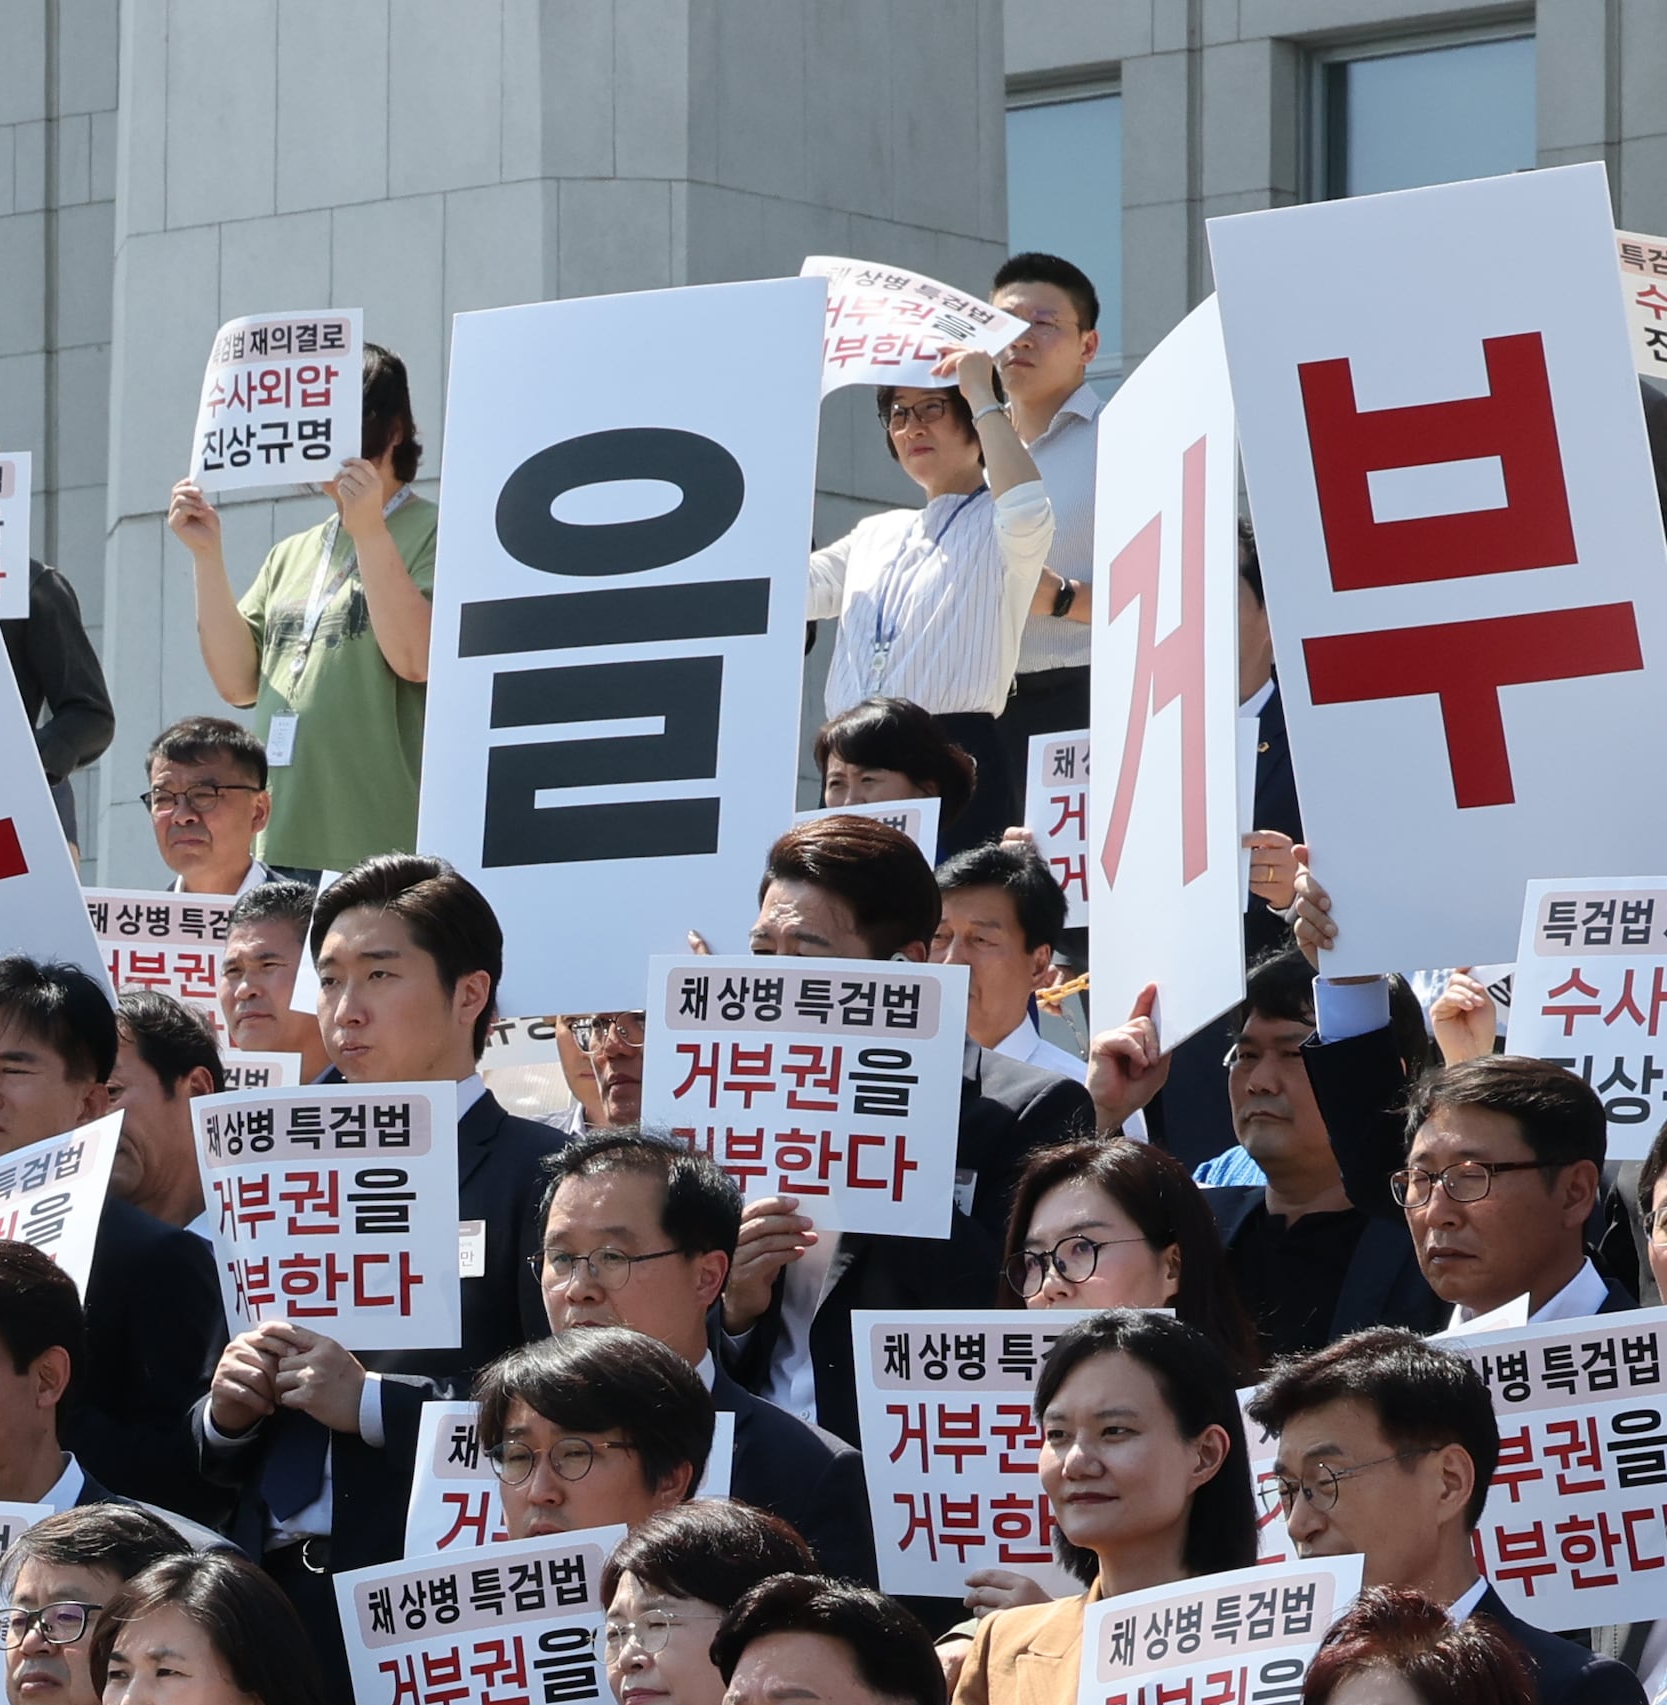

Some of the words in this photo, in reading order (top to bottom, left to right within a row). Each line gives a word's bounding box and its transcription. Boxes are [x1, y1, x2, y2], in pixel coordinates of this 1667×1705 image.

[916, 283, 994, 324] 특검법
[249, 325, 346, 357] 재의결로
[208, 365, 339, 415] 수사외압
[201, 417, 333, 471] 진상규명
[1298, 331, 1644, 809] 부
[459, 427, 771, 869] 을
[1100, 435, 1208, 891] 거
[116, 904, 170, 935] 상병
[1542, 898, 1655, 947] 특검법
[681, 977, 710, 1022] 채
[717, 977, 786, 1022] 상병
[797, 982, 922, 1030] 특검법
[672, 1042, 918, 1118] 거부권을
[206, 1117, 221, 1159] 채
[223, 1106, 276, 1153] 상병
[285, 1102, 411, 1151] 특검법
[213, 1167, 417, 1245] 거부권을
[227, 1250, 423, 1322] 거부한다
[883, 1332, 911, 1380] 채
[918, 1332, 987, 1381] 상병
[1540, 1332, 1660, 1395] 특검법
[892, 1492, 1057, 1565] 거부한
[369, 1590, 396, 1636] 채
[401, 1577, 460, 1627] 상병
[469, 1555, 587, 1608] 특검법
[1109, 1615, 1135, 1666] 채
[1142, 1606, 1202, 1660] 상병
[1211, 1582, 1317, 1646] 특검법
